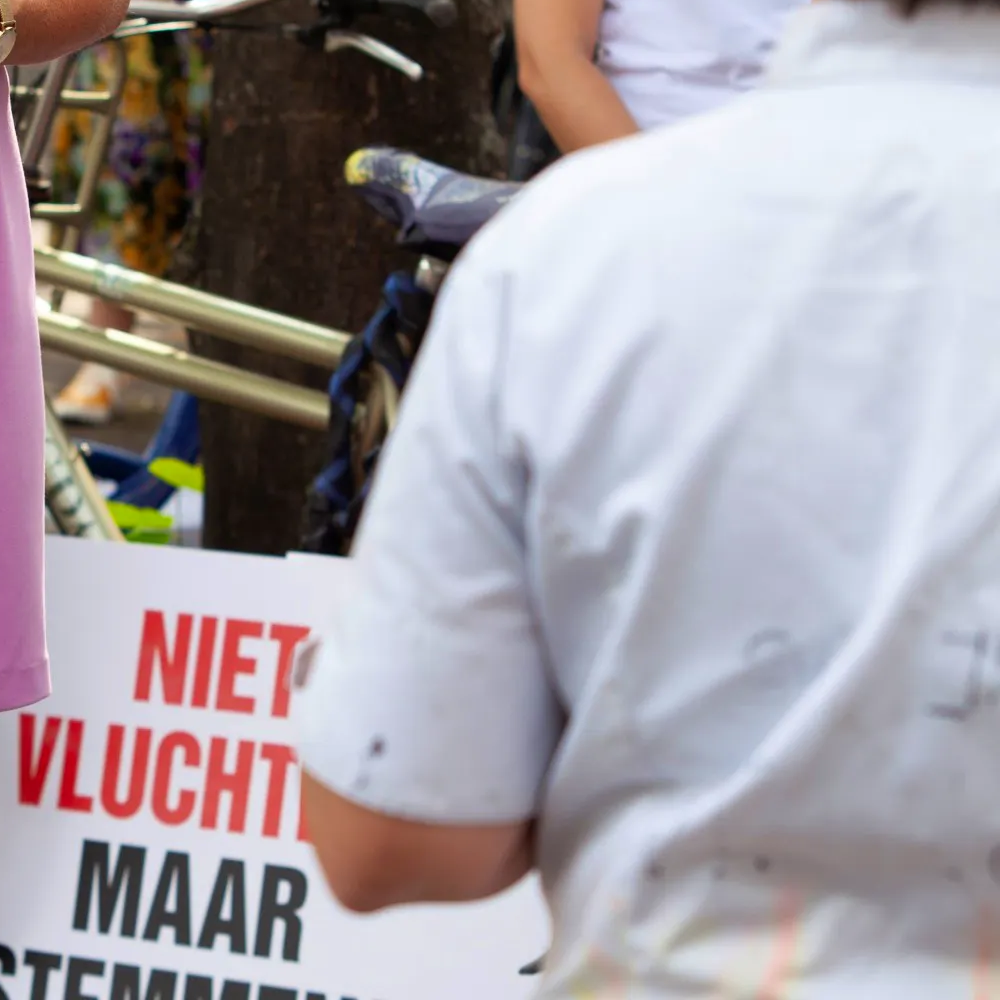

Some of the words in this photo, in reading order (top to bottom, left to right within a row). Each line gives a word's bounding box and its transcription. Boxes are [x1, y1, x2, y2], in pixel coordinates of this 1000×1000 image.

[133, 609, 312, 719] NIET
[18, 713, 312, 843] VLUCHT
[72, 839, 308, 963] MAAR
